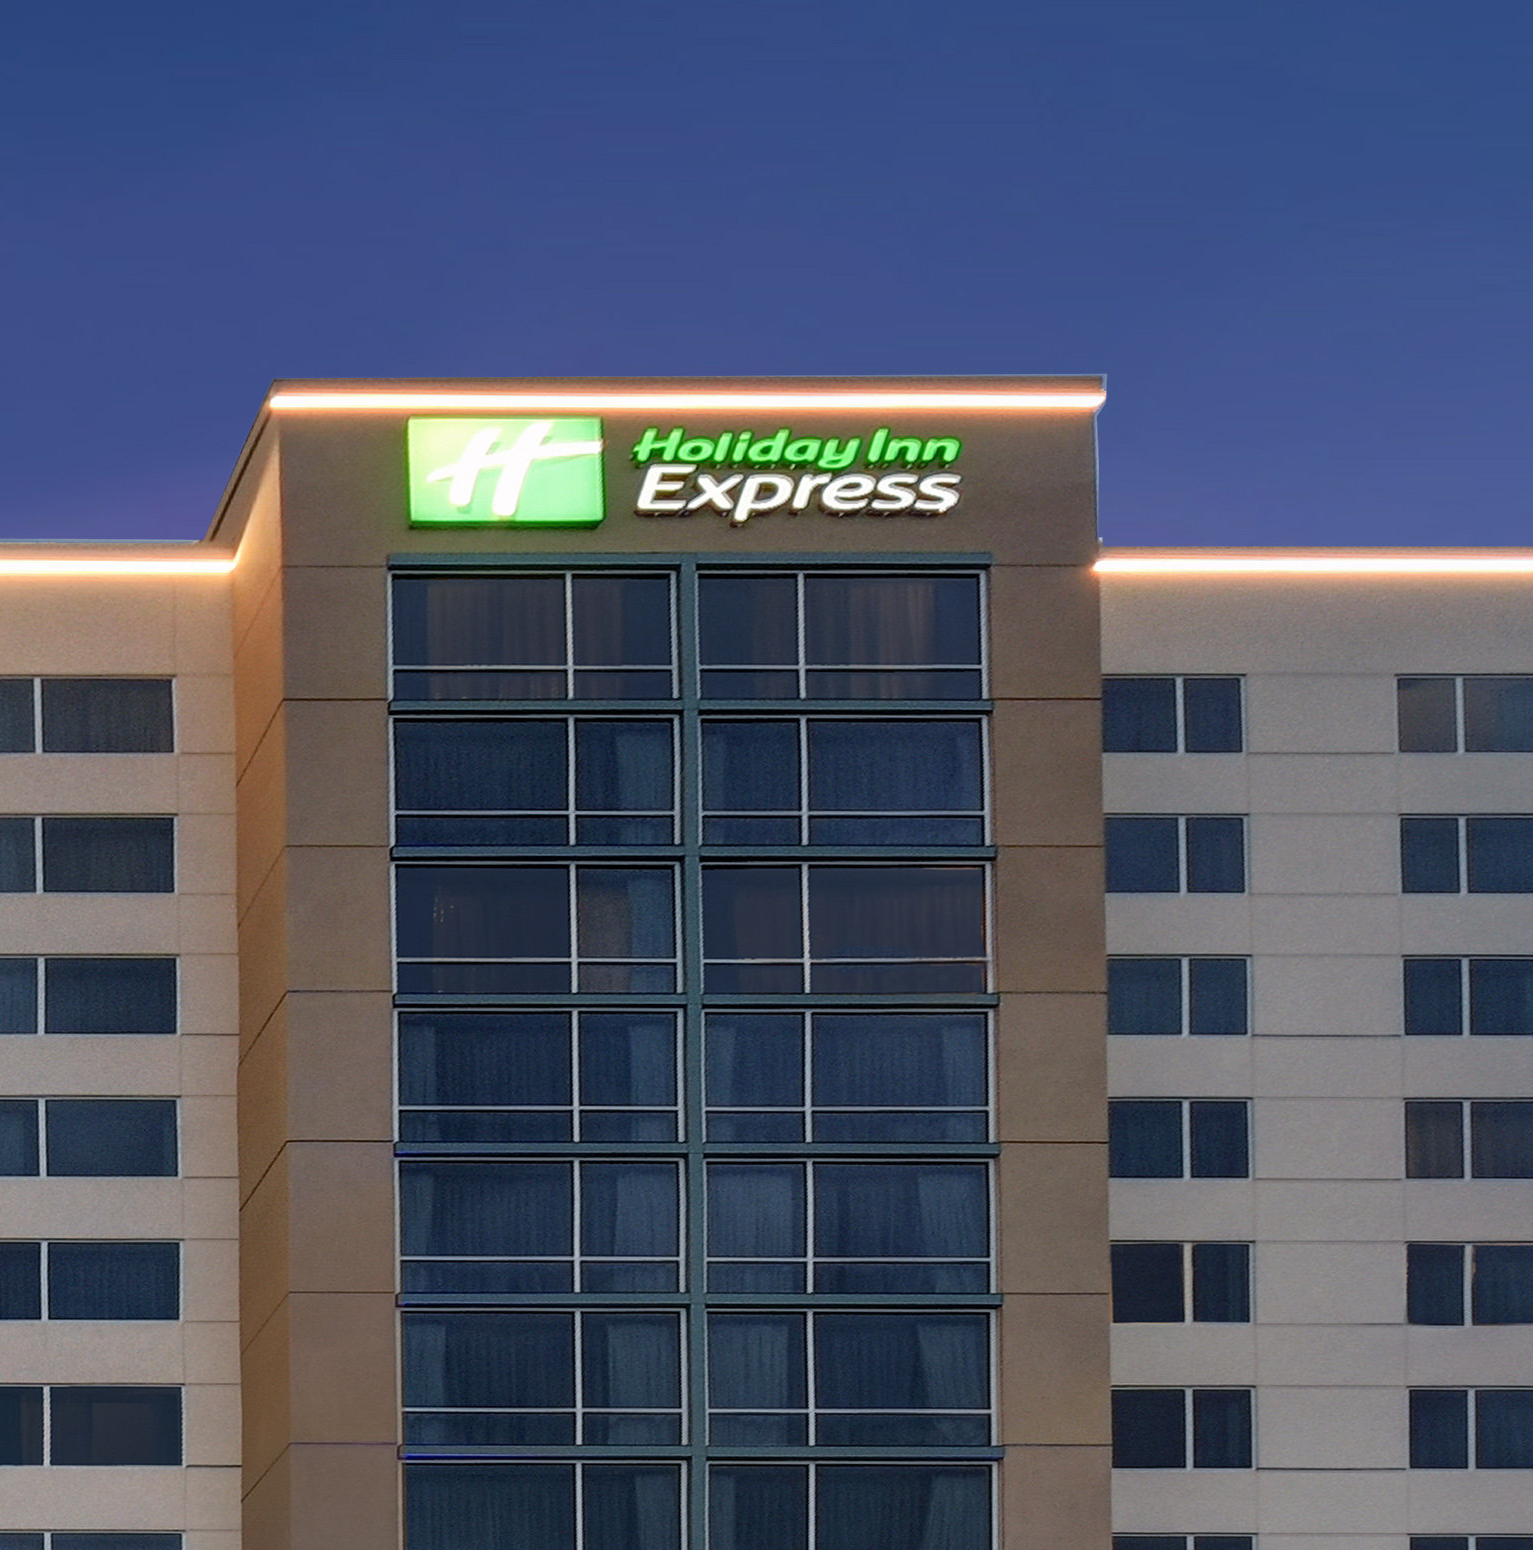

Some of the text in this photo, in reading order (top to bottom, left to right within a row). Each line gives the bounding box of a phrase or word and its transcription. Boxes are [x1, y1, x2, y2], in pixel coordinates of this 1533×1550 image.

[634, 428, 961, 470] Holiday Inn
[636, 464, 961, 524] Express
